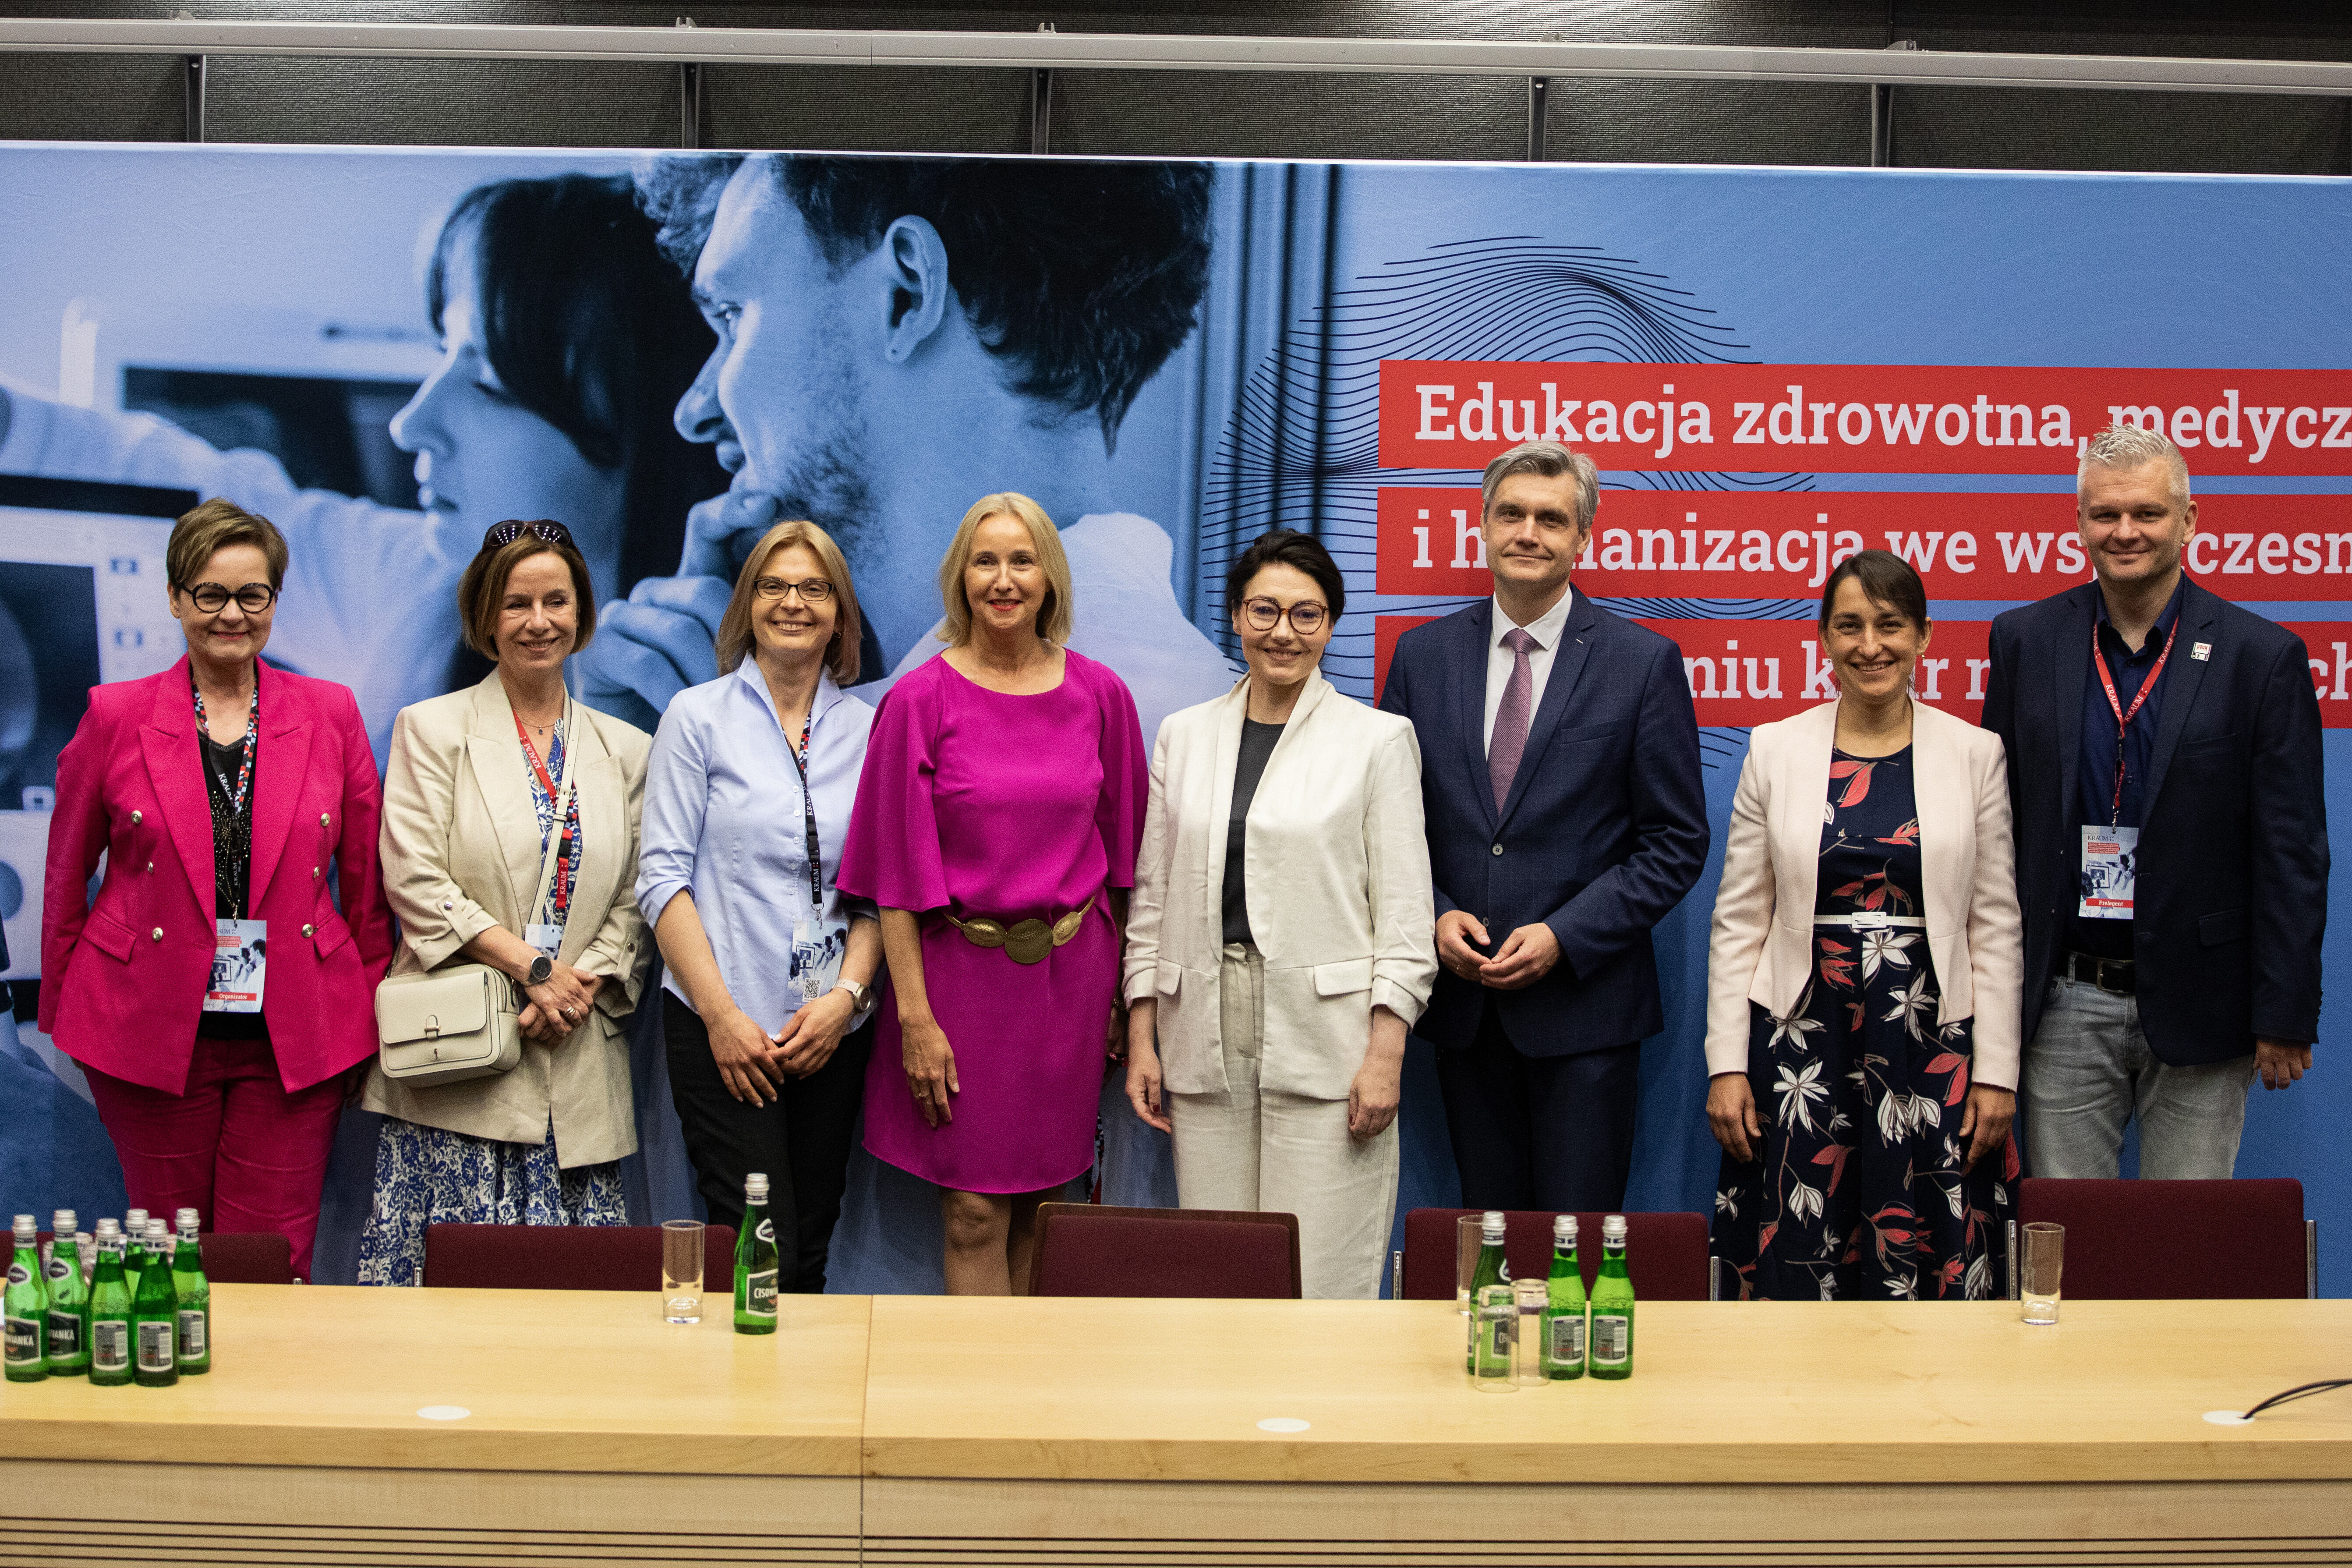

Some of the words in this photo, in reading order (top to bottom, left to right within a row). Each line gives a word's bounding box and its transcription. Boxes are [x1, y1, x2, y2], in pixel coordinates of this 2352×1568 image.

[1415, 382, 1714, 458] Edukacja
[1733, 385, 2088, 459] zdrowotna,
[1413, 509, 1433, 568] i
[1450, 510, 1864, 588] hanizacja
[1885, 531, 1977, 573] we
[1995, 531, 2352, 583] wsczesn
[2158, 638, 2173, 665] KRAUM
[2105, 684, 2120, 711] KRAUM
[2125, 695, 2143, 721] KRAUM
[524, 743, 541, 769] KRAUM
[218, 773, 233, 800] KRAUM
